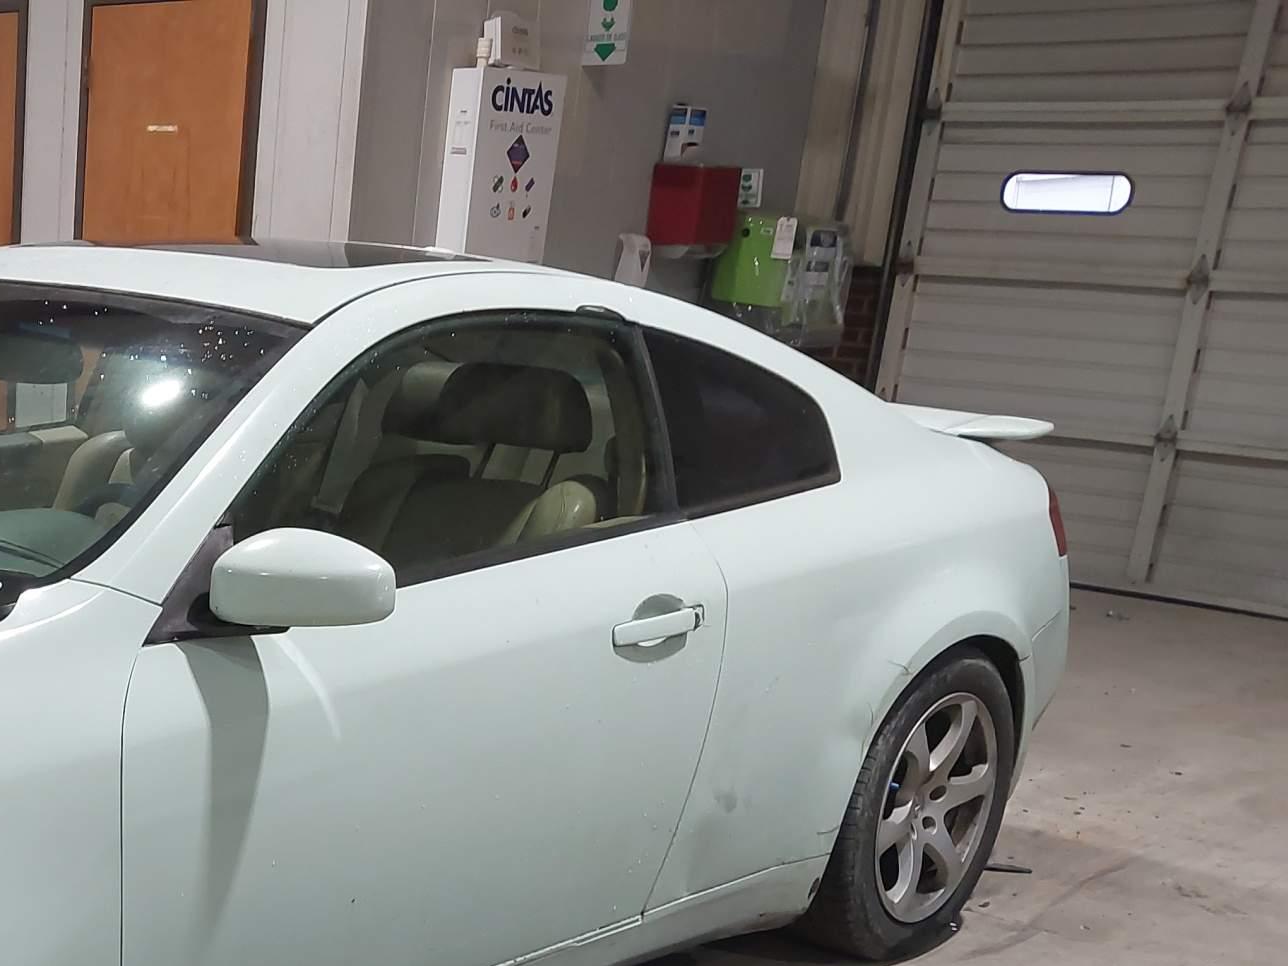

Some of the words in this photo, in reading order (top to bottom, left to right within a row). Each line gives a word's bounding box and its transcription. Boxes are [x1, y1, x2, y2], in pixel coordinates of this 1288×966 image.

[489, 119, 508, 133] First
[509, 121, 524, 134] Aid
[525, 122, 553, 135] Center
